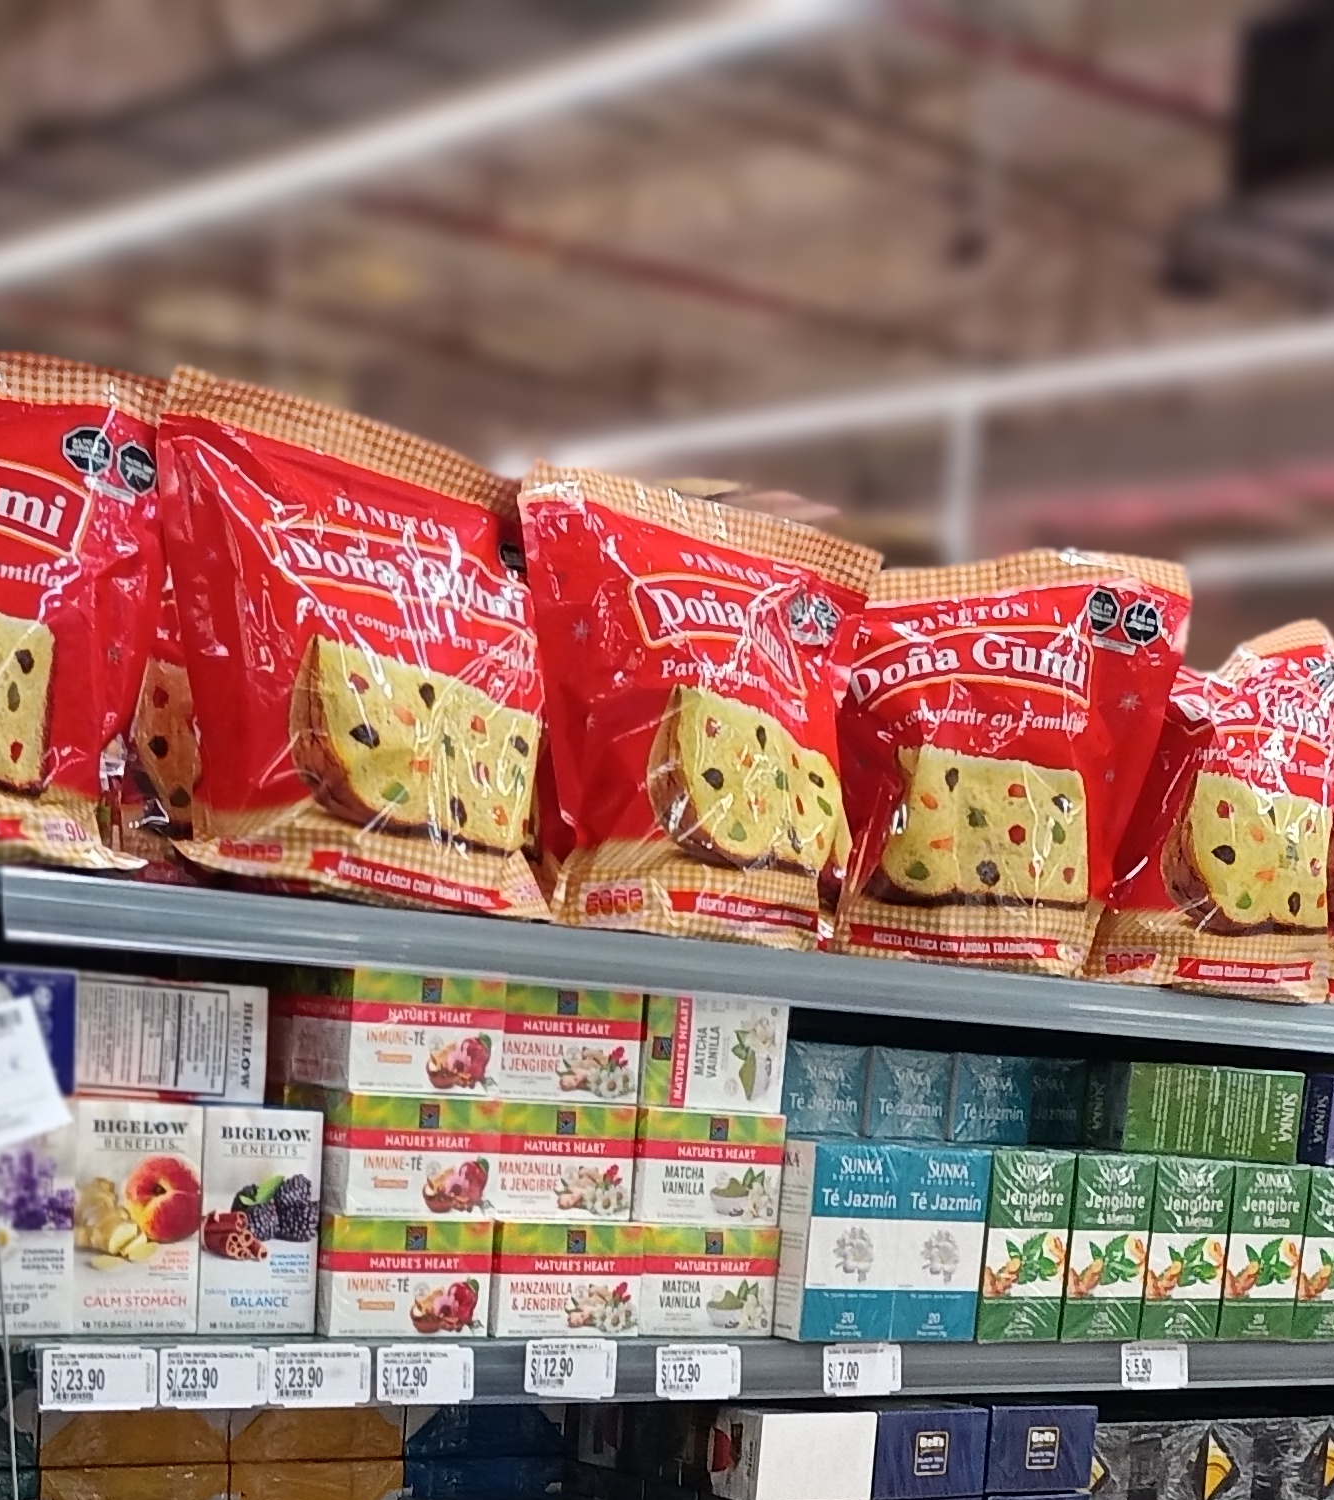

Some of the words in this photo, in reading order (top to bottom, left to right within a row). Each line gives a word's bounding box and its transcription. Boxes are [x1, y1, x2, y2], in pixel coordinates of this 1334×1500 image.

[334, 497, 458, 542] PANETÓN
[289, 537, 400, 587] Doña
[657, 586, 743, 631] Doña
[905, 602, 1029, 632] PANETÓN
[851, 644, 961, 704] Doña
[972, 637, 1088, 689] Gumi
[338, 861, 373, 883] RECETA
[373, 868, 411, 890] CLÁSICA
[412, 876, 433, 892] CON
[388, 1007, 437, 1023] NATURE'S
[439, 1010, 473, 1024] HEART
[523, 1020, 574, 1035] NATURE'S
[577, 1022, 611, 1036] HEART
[240, 1001, 254, 1090] BIGELOW
[694, 1027, 707, 1076] MATCHA
[707, 1026, 720, 1078] VAINILLA
[93, 1118, 190, 1136] BIGELOW
[103, 1137, 177, 1150] BENEFITS
[384, 1134, 434, 1148] NATURE'S
[436, 1135, 471, 1149] HEART
[523, 1140, 571, 1154] NATURE'S
[574, 1141, 606, 1154] HEART
[231, 1144, 299, 1157] BENEFITS
[677, 1146, 724, 1160] NATURE'S
[727, 1147, 757, 1161] HEART
[498, 1161, 563, 1177] MANZANILLA
[664, 1166, 705, 1181] MATCHA
[840, 1155, 883, 1175] SUNKA
[927, 1159, 969, 1179] SUNKA
[509, 1178, 558, 1192] JENGIBRE
[661, 1181, 705, 1196] VAINILLA
[822, 1188, 839, 1207] Té
[843, 1188, 897, 1209] Jazmín
[911, 1193, 927, 1211] Té
[930, 1192, 982, 1214] Jazmín
[1000, 1188, 1065, 1209] Jengibre
[1085, 1191, 1146, 1211] Jengibre
[1164, 1195, 1224, 1214] Jengibre
[1243, 1194, 1301, 1214] Jengibre
[369, 1256, 422, 1270] NATURE'S
[425, 1257, 459, 1271] HEART
[534, 1260, 580, 1272] NATURE'S
[583, 1260, 616, 1273] HEART
[510, 1281, 573, 1295] MANZANILLA
[661, 1279, 702, 1294] MATCHA
[83, 1296, 122, 1307] CALM
[125, 1296, 187, 1307] STOMACH
[230, 1296, 289, 1307] BALANCE
[521, 1297, 568, 1311] JENGIBRE
[659, 1295, 702, 1310] VAINILLA
